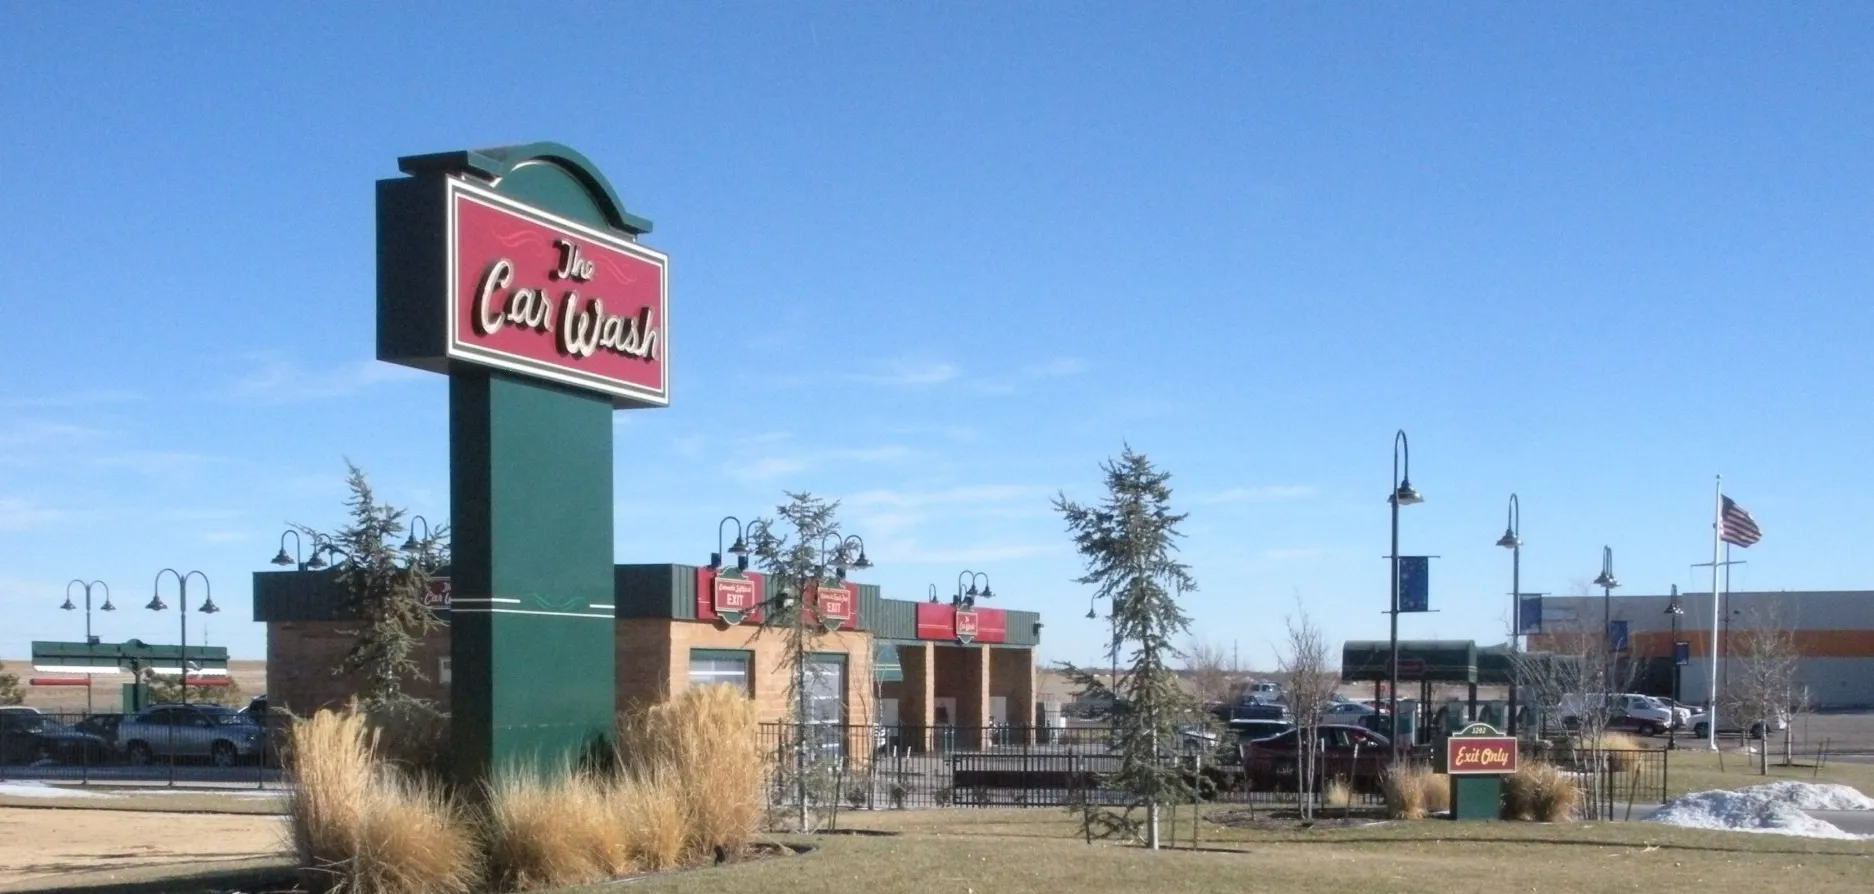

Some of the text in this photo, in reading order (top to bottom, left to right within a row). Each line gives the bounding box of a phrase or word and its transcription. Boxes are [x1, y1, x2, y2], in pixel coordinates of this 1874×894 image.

[555, 239, 594, 280] The
[477, 258, 659, 361] Car Wash
[726, 593, 744, 606] EXIT
[826, 602, 841, 613] EXIT
[1455, 746, 1509, 766] Exit Only
